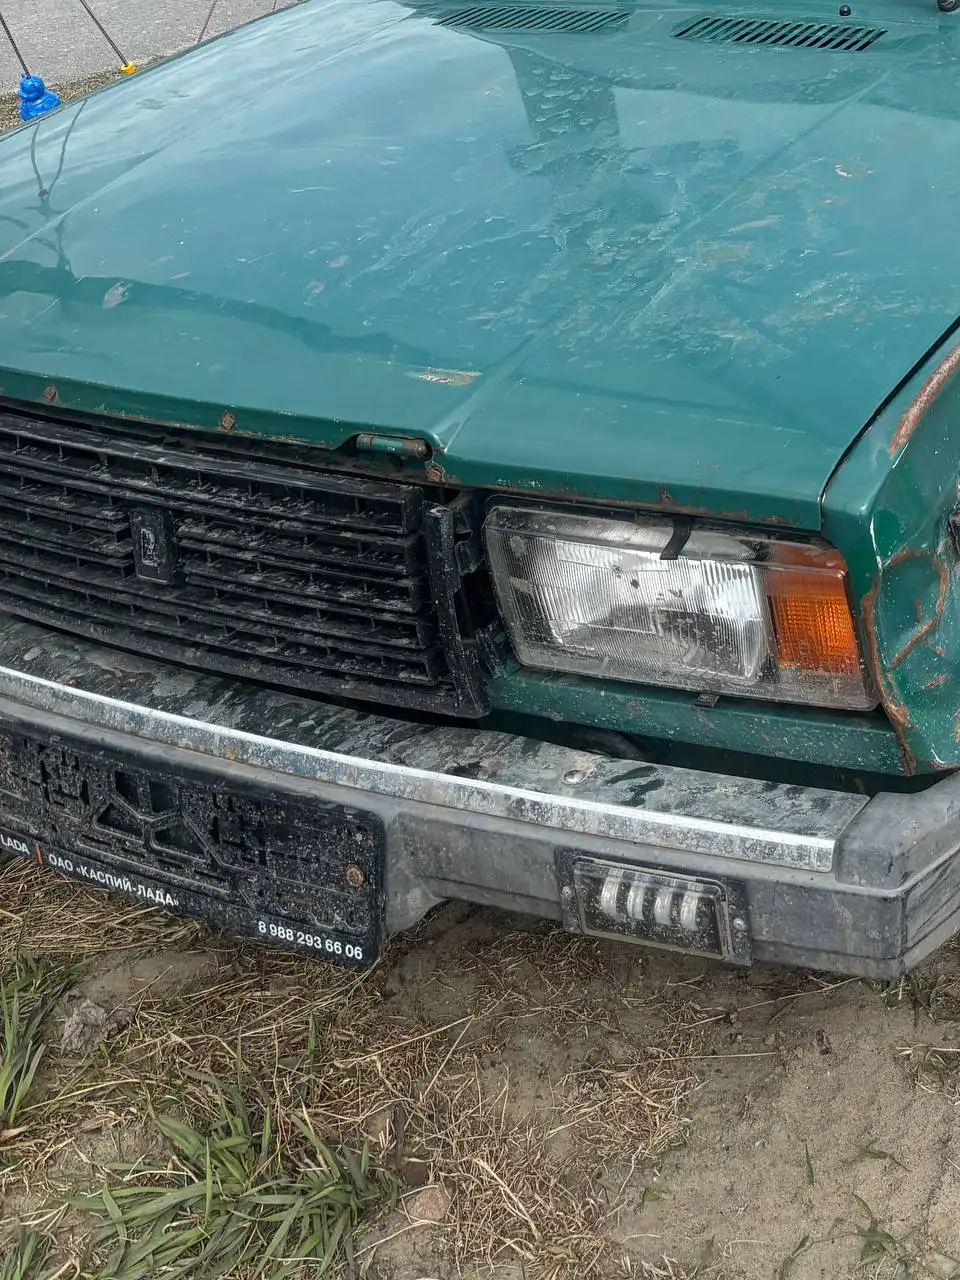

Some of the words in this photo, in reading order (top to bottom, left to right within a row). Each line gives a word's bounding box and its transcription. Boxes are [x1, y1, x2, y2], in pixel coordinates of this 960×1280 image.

[0, 834, 30, 855] LADA
[48, 853, 74, 872] ОАО
[76, 864, 179, 907] «КАСПИЙ-ЛАДА»
[258, 920, 267, 933] 8
[269, 923, 294, 941] 988
[296, 931, 322, 949] 293
[325, 939, 343, 955] 66
[345, 944, 363, 960] 06
